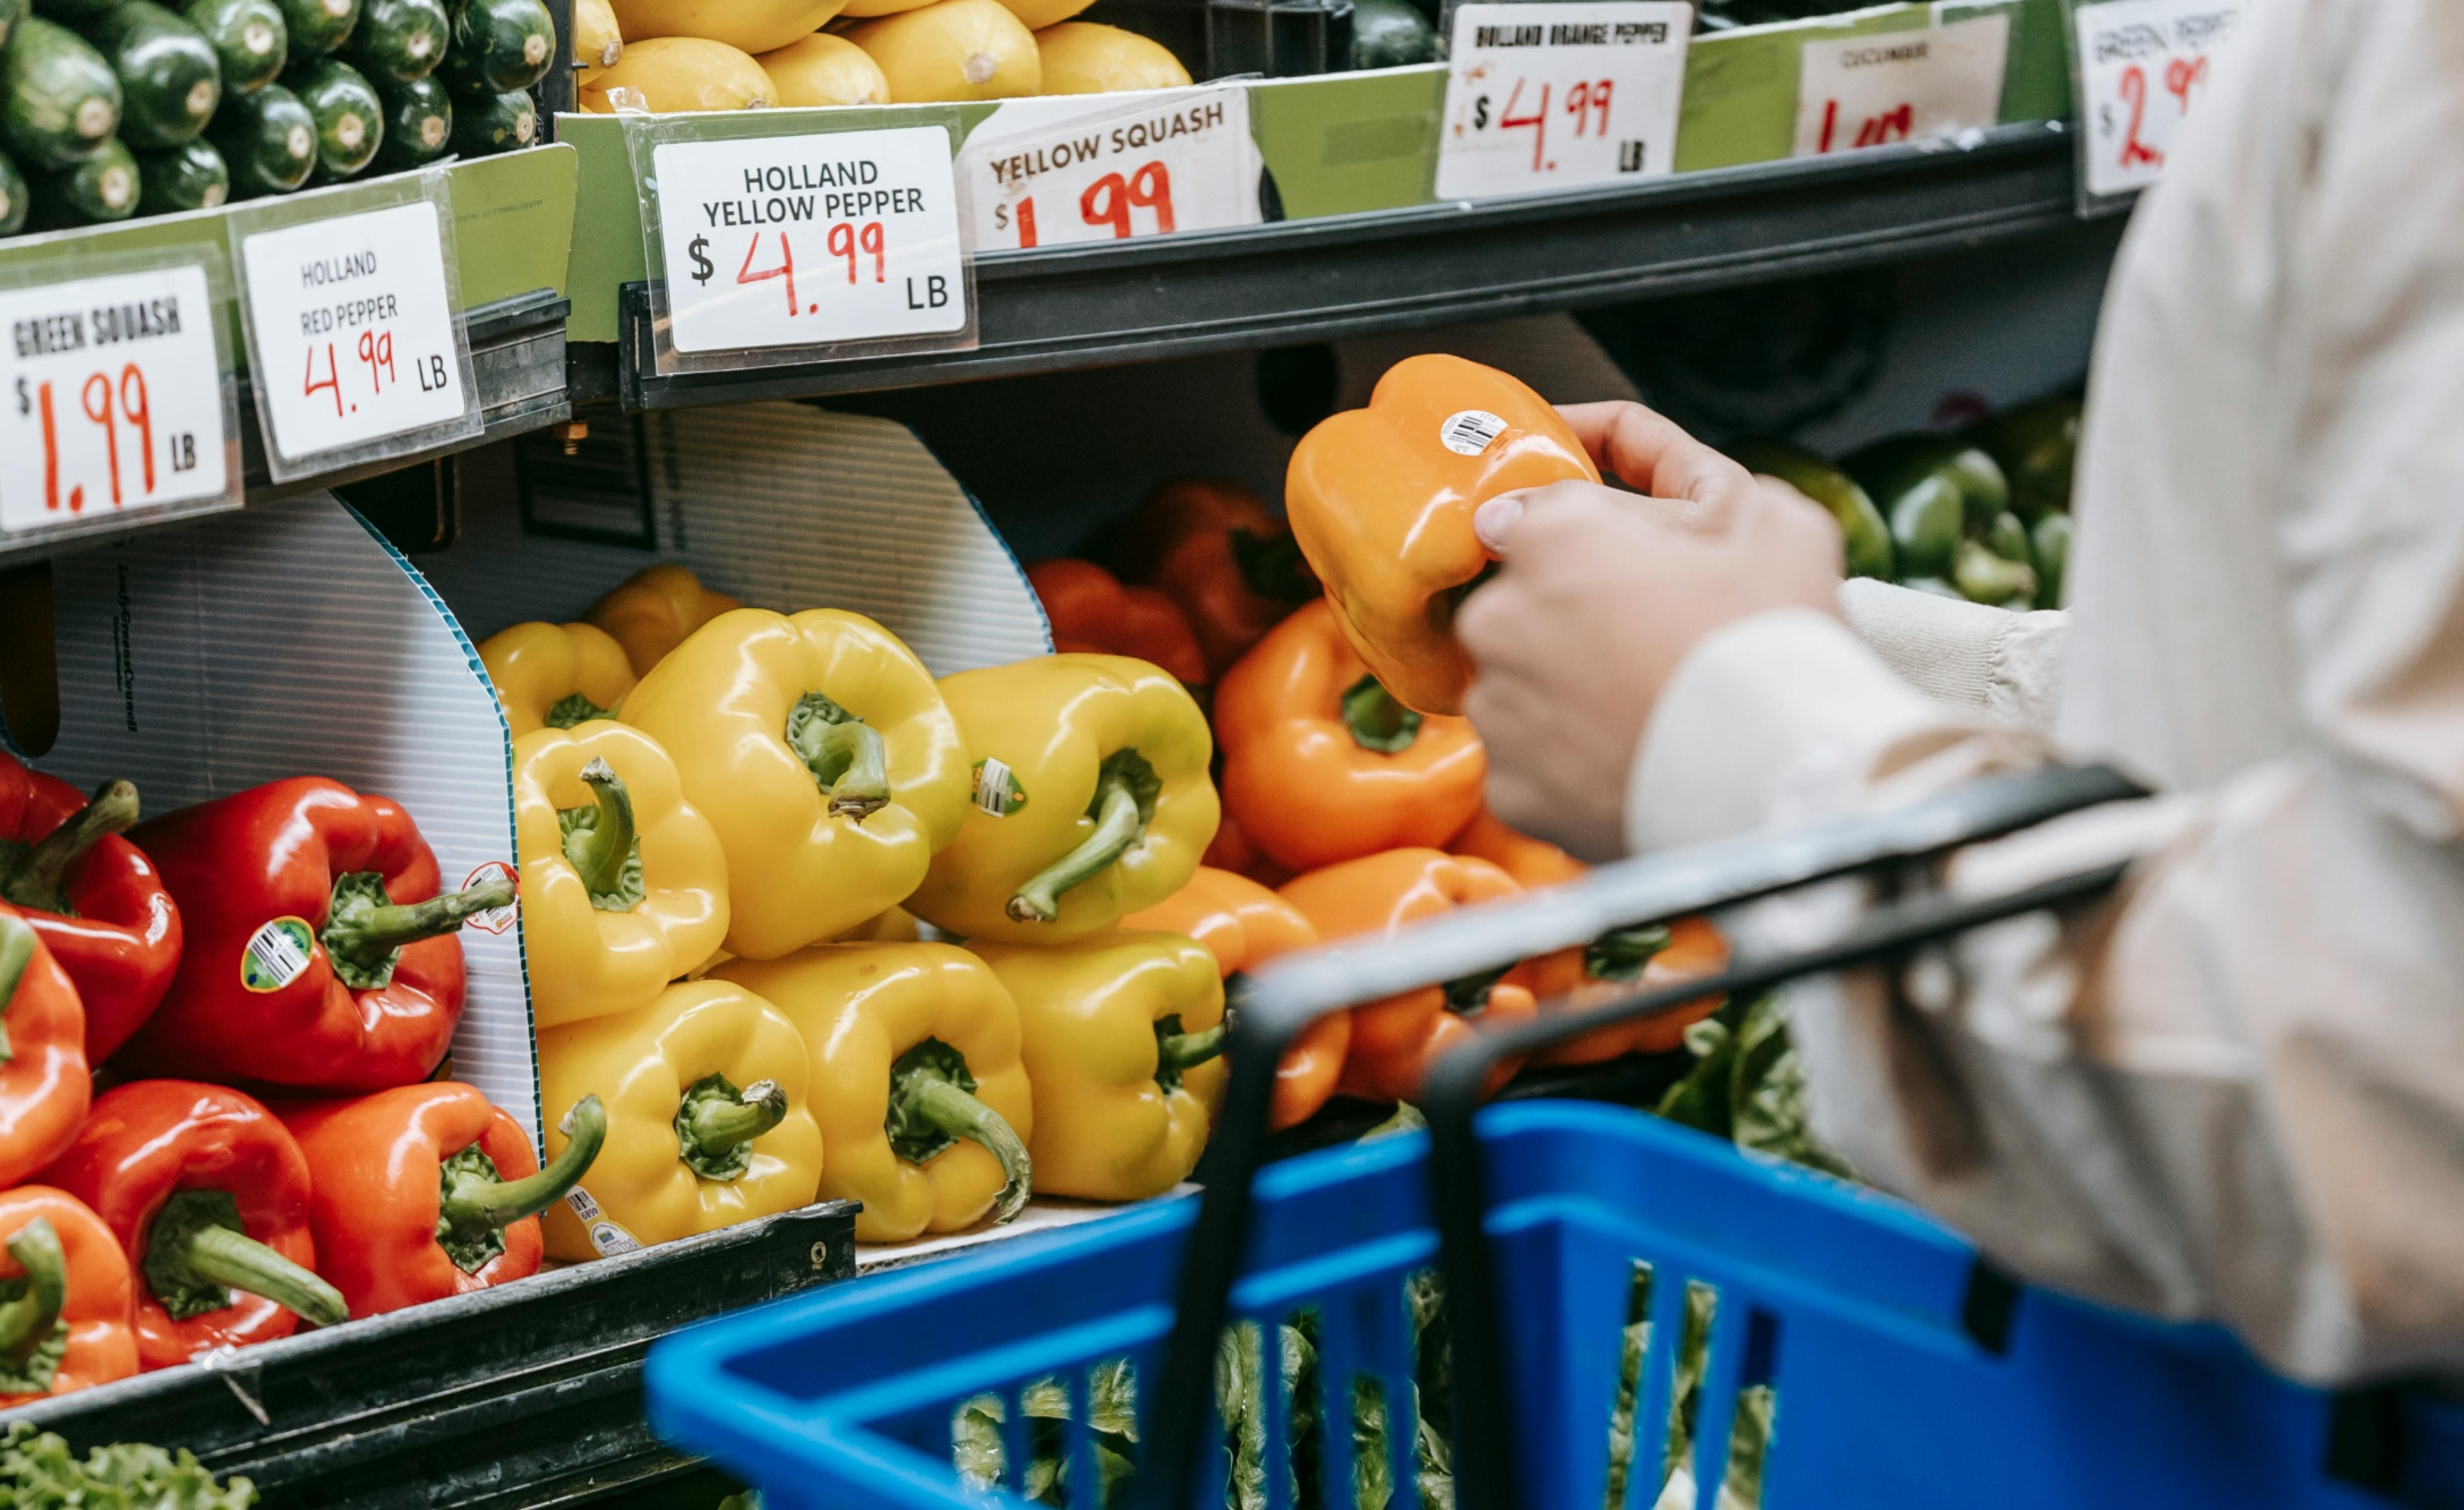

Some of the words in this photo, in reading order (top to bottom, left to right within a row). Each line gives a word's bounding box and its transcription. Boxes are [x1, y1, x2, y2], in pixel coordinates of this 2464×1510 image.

[1476, 24, 1542, 48] HOLLAND
[1550, 23, 1608, 45] ORANGE
[1615, 22, 1668, 44] PEPPER
[990, 134, 1101, 183] YELLOW
[1112, 103, 1223, 153] SQUASH
[1619, 140, 1644, 173] LB
[744, 160, 879, 193] HOLLAND
[703, 196, 815, 227] YELLOW
[825, 188, 926, 219] PEPPER
[302, 250, 377, 288] HOLLAND
[737, 222, 885, 317] 4.99
[906, 275, 948, 310] LB
[15, 313, 86, 357] GREEN
[92, 295, 181, 345] SQUASH
[301, 307, 334, 336] RED
[337, 294, 399, 328] PEPPER
[305, 329, 395, 418] 4.99
[417, 354, 448, 393] LB
[171, 433, 196, 472] LB
